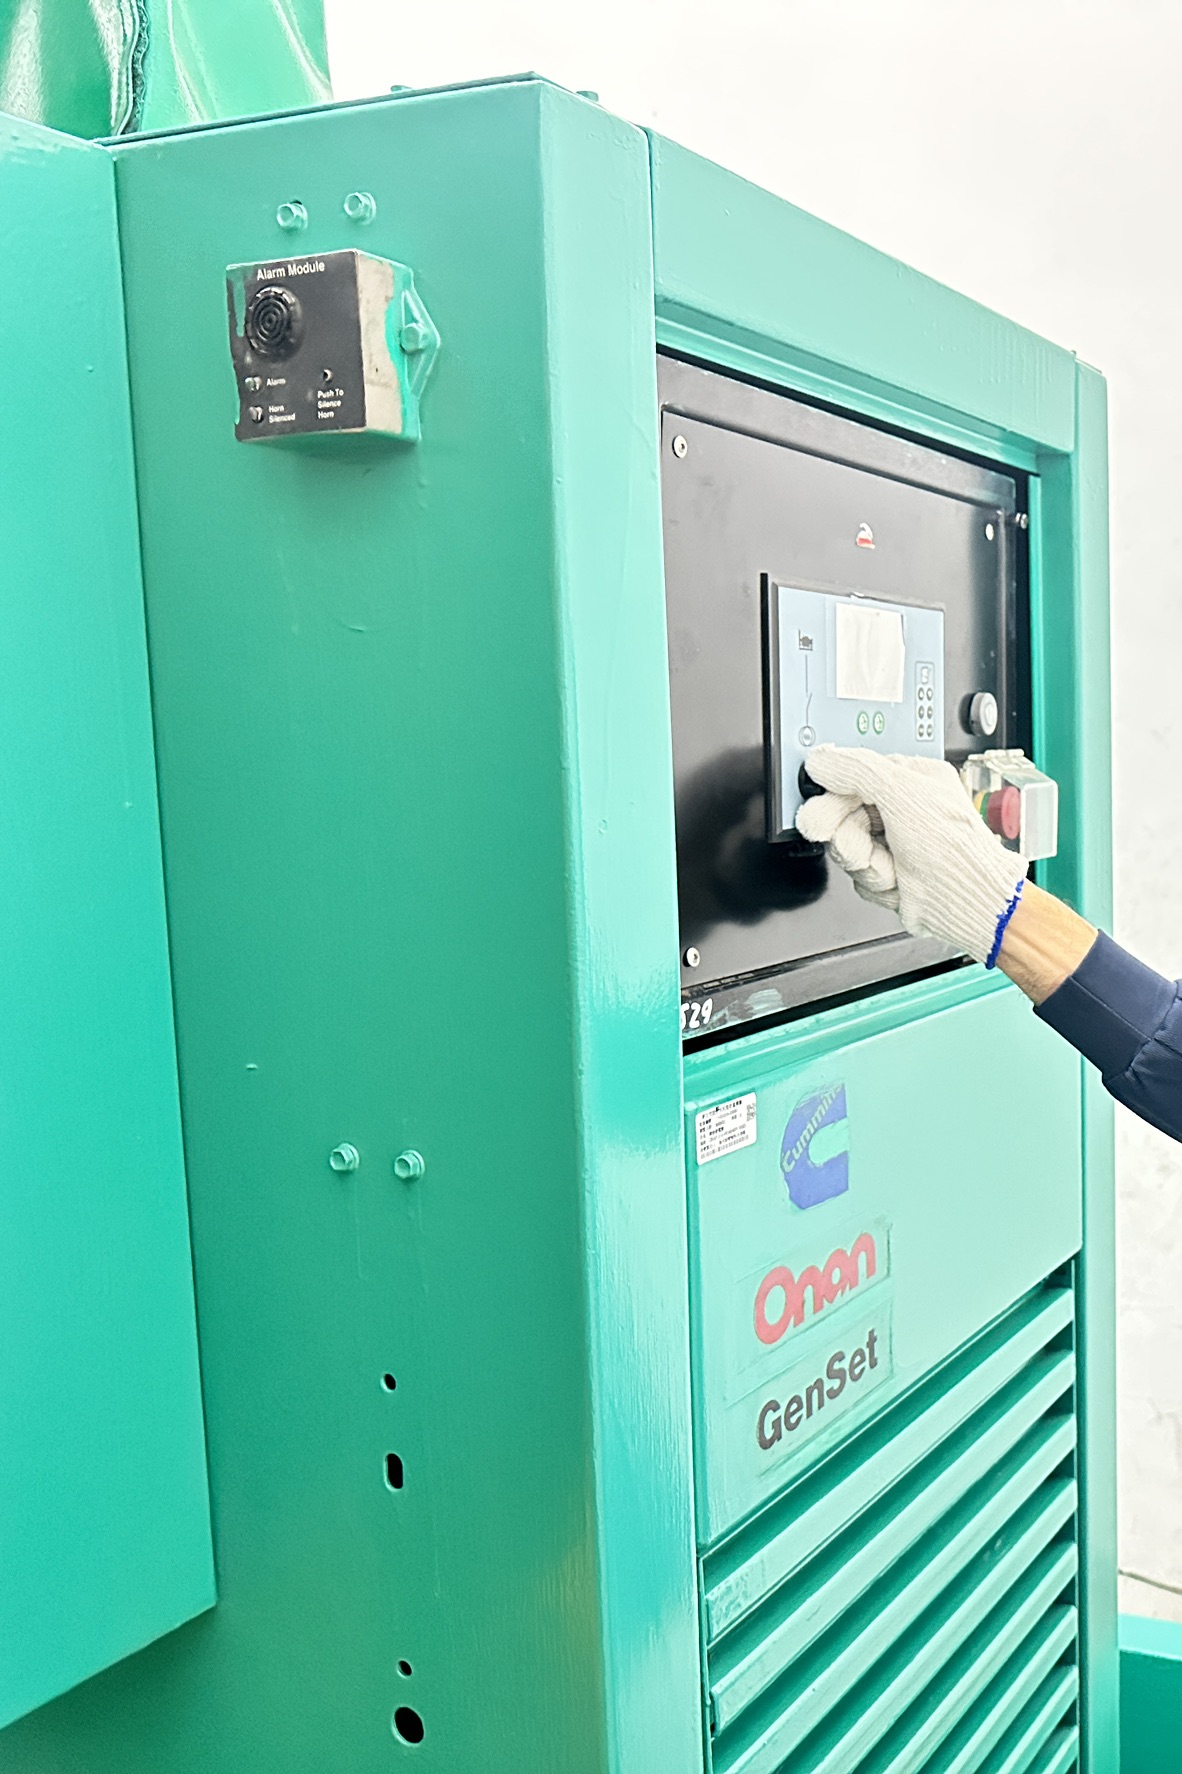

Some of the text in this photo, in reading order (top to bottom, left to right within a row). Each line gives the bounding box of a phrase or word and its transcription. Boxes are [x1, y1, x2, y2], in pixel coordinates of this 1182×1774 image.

[257, 260, 326, 281] Alarm Module
[266, 378, 287, 387] Alarm
[317, 388, 345, 399] Push To
[268, 405, 285, 413] Horn
[317, 400, 342, 409] Silence
[268, 413, 296, 424] Silenced
[317, 411, 335, 419] Horn
[753, 1232, 876, 1345] Onan
[756, 1327, 878, 1451] GenSet
